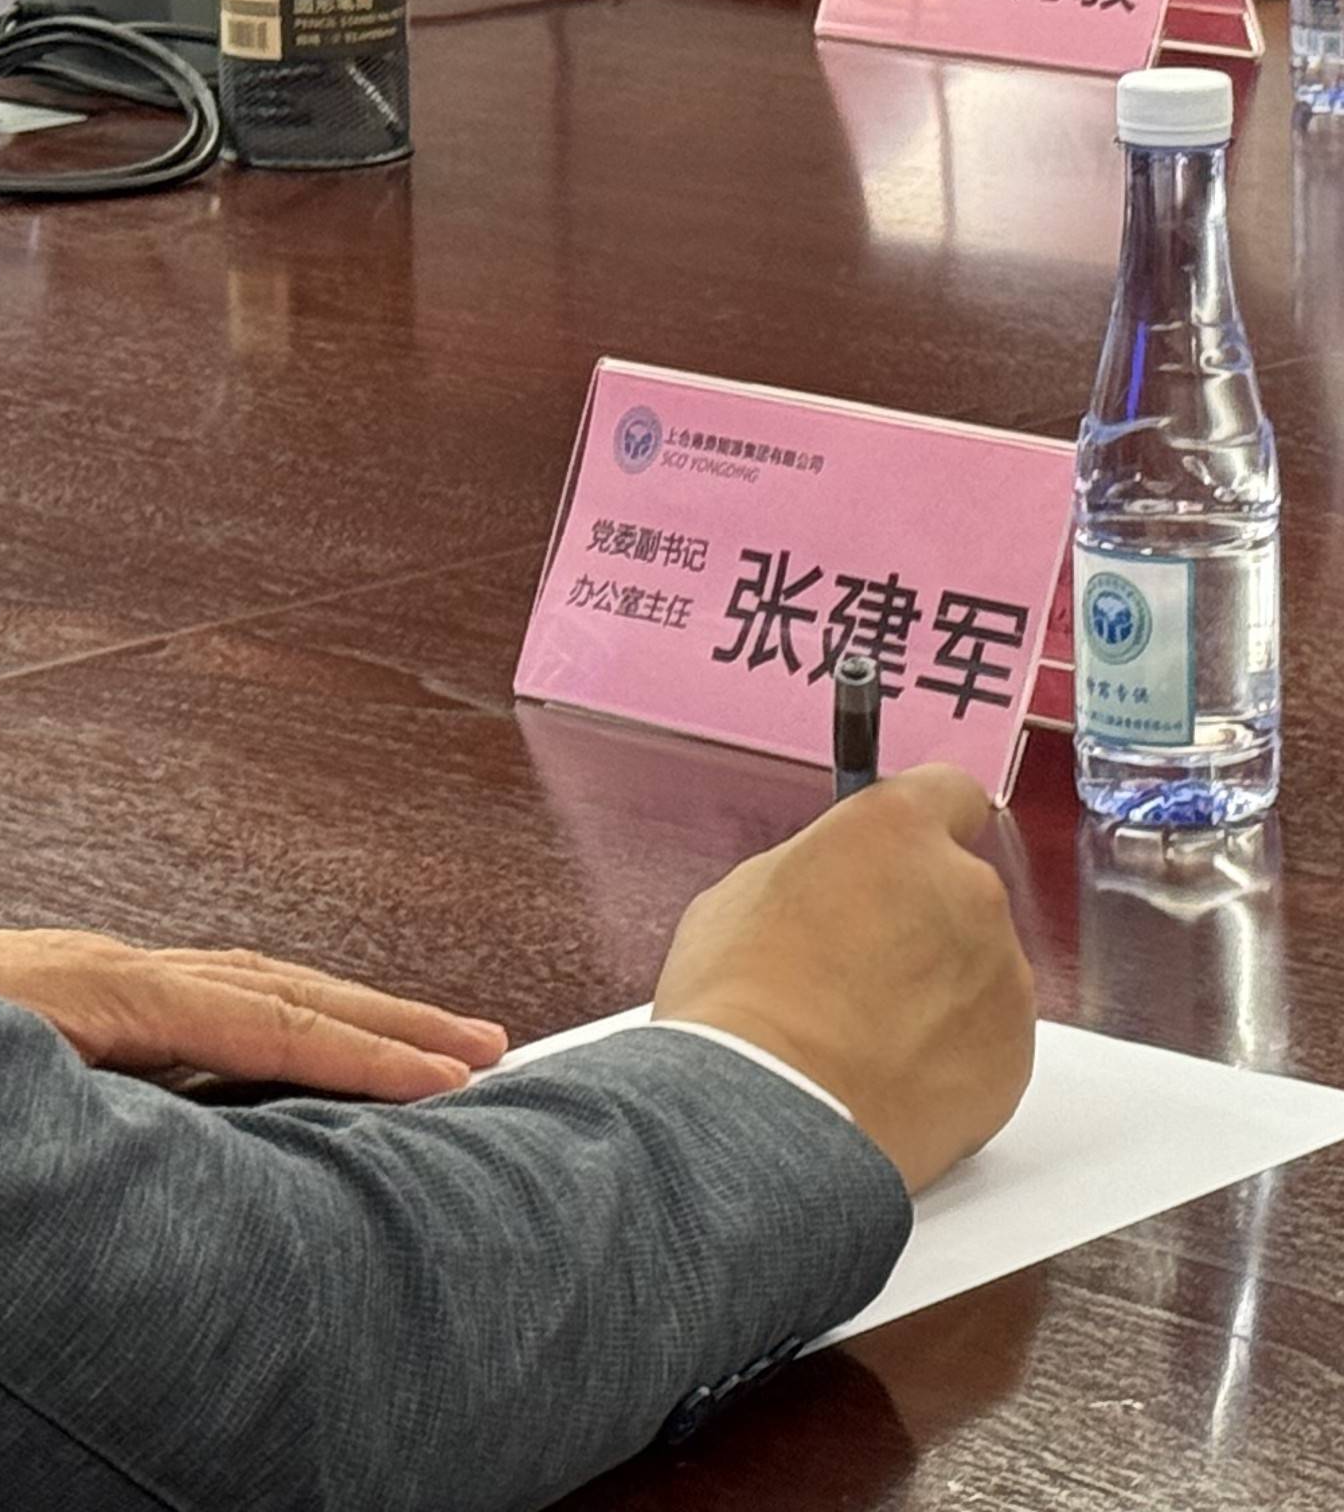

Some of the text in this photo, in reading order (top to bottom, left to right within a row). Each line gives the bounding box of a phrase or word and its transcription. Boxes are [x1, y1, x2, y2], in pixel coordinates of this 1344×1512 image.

[585, 518, 710, 573] 党委副书记
[566, 573, 695, 630] 办公室主任
[711, 548, 1030, 720] 张建军
